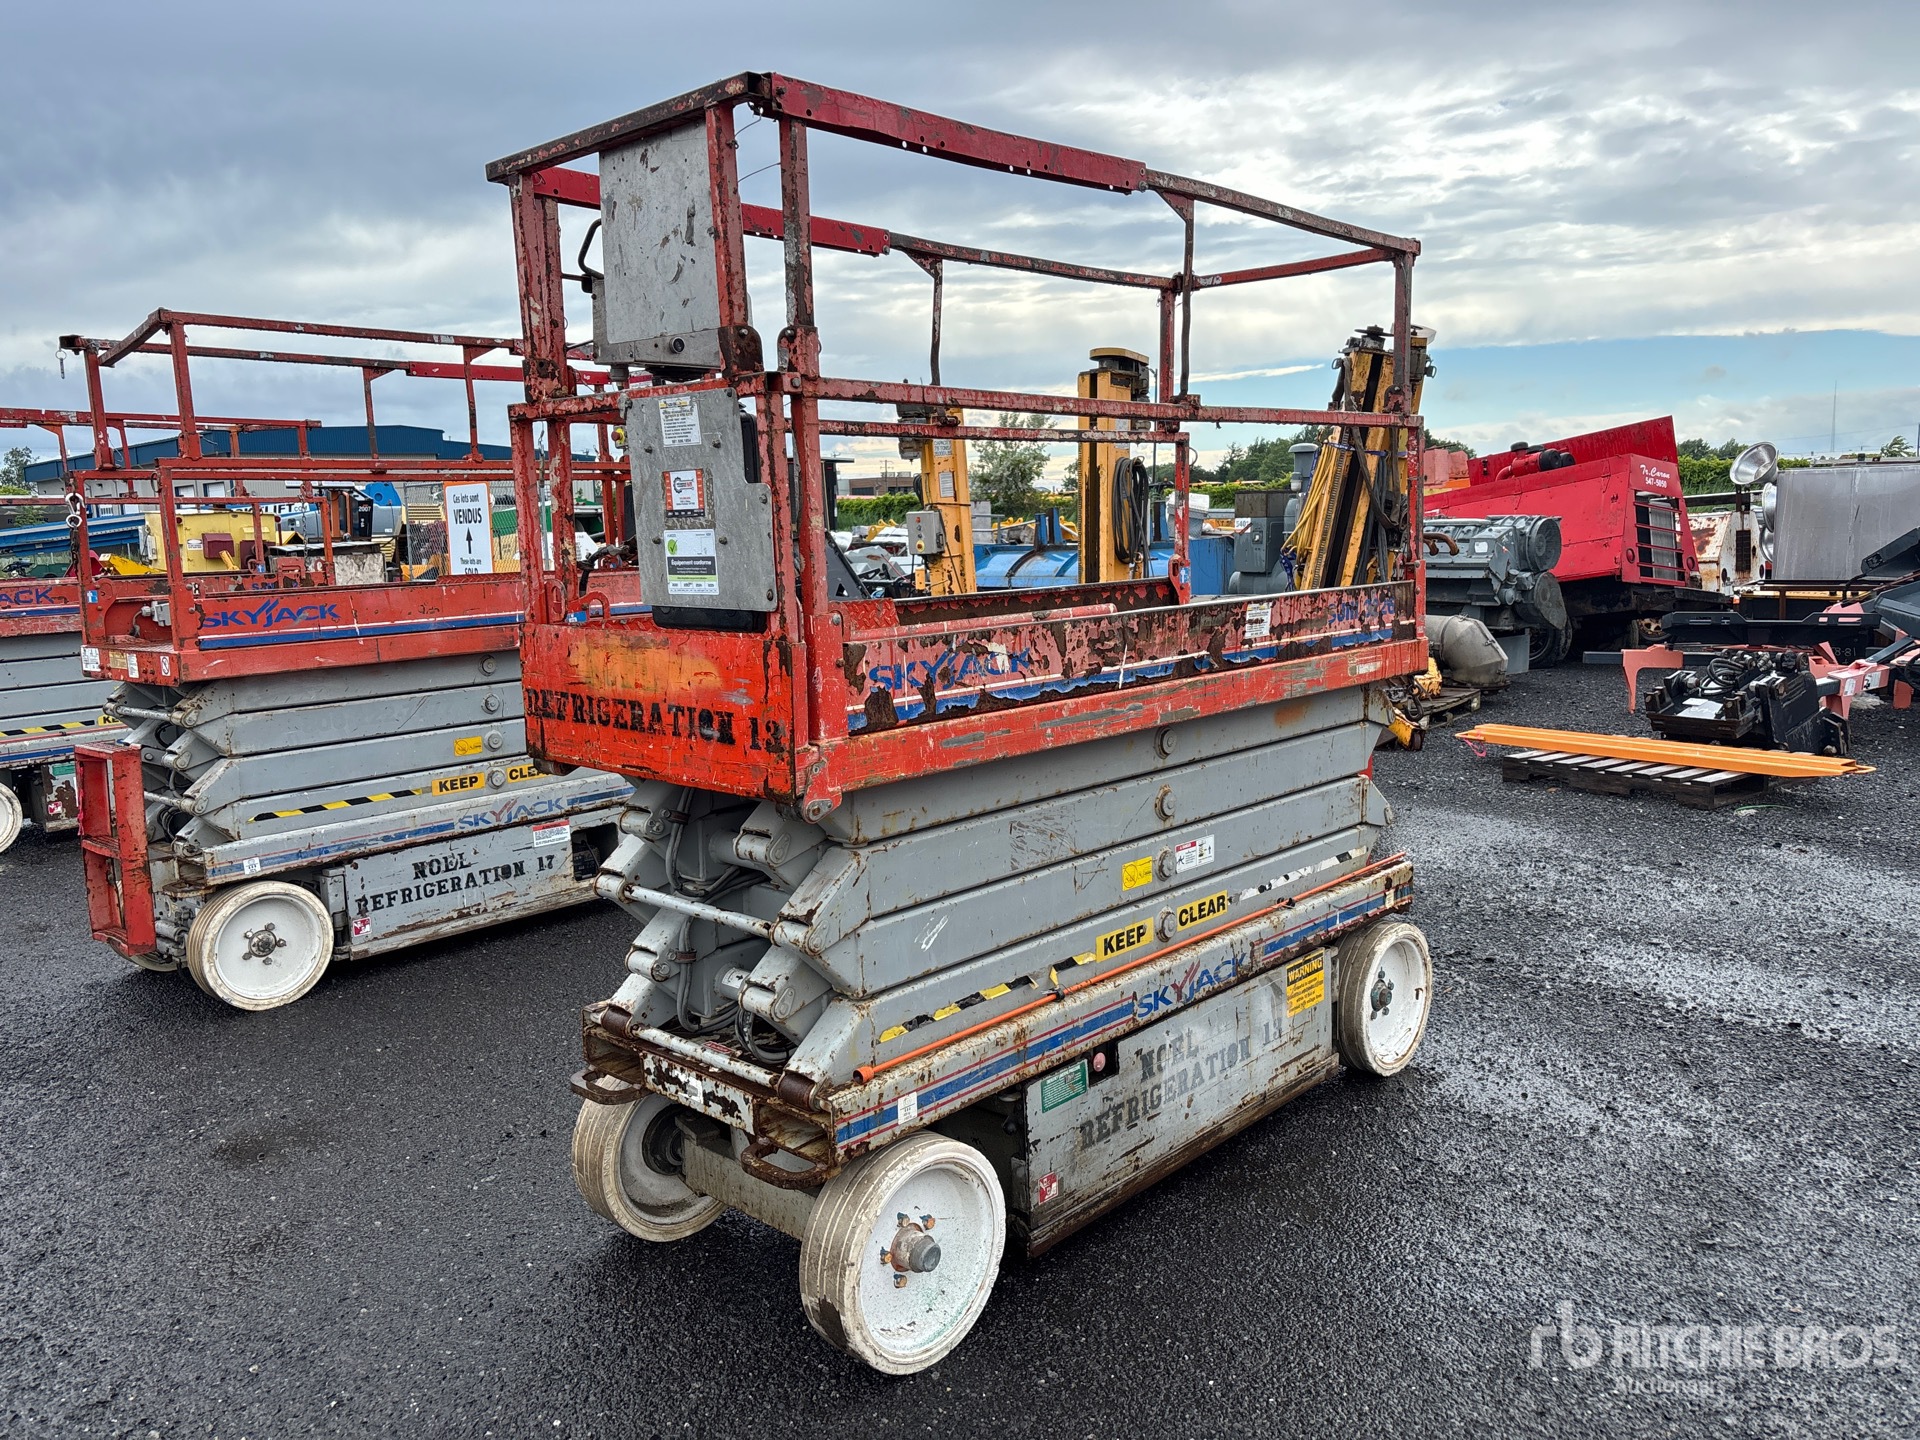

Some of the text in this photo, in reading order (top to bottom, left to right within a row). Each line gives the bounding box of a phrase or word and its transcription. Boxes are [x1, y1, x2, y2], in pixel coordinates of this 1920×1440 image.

[461, 493, 469, 503] lots
[470, 493, 480, 503] sont
[454, 508, 482, 525] VENDUS
[202, 599, 340, 628] SKYJACK
[869, 640, 1031, 692] SKYJACK
[525, 688, 736, 746] REFRIGERATION
[438, 775, 479, 793] KEEP
[459, 797, 565, 830] SKYJACK
[412, 852, 471, 880] NOEL
[355, 855, 555, 916] REFRIGERATION 17
[1103, 894, 1226, 957] KEEP CLEAR
[1137, 952, 1247, 1018] SKYJACK
[1288, 957, 1323, 983] WARNING
[1080, 1036, 1251, 1151] REFRIGERATION
